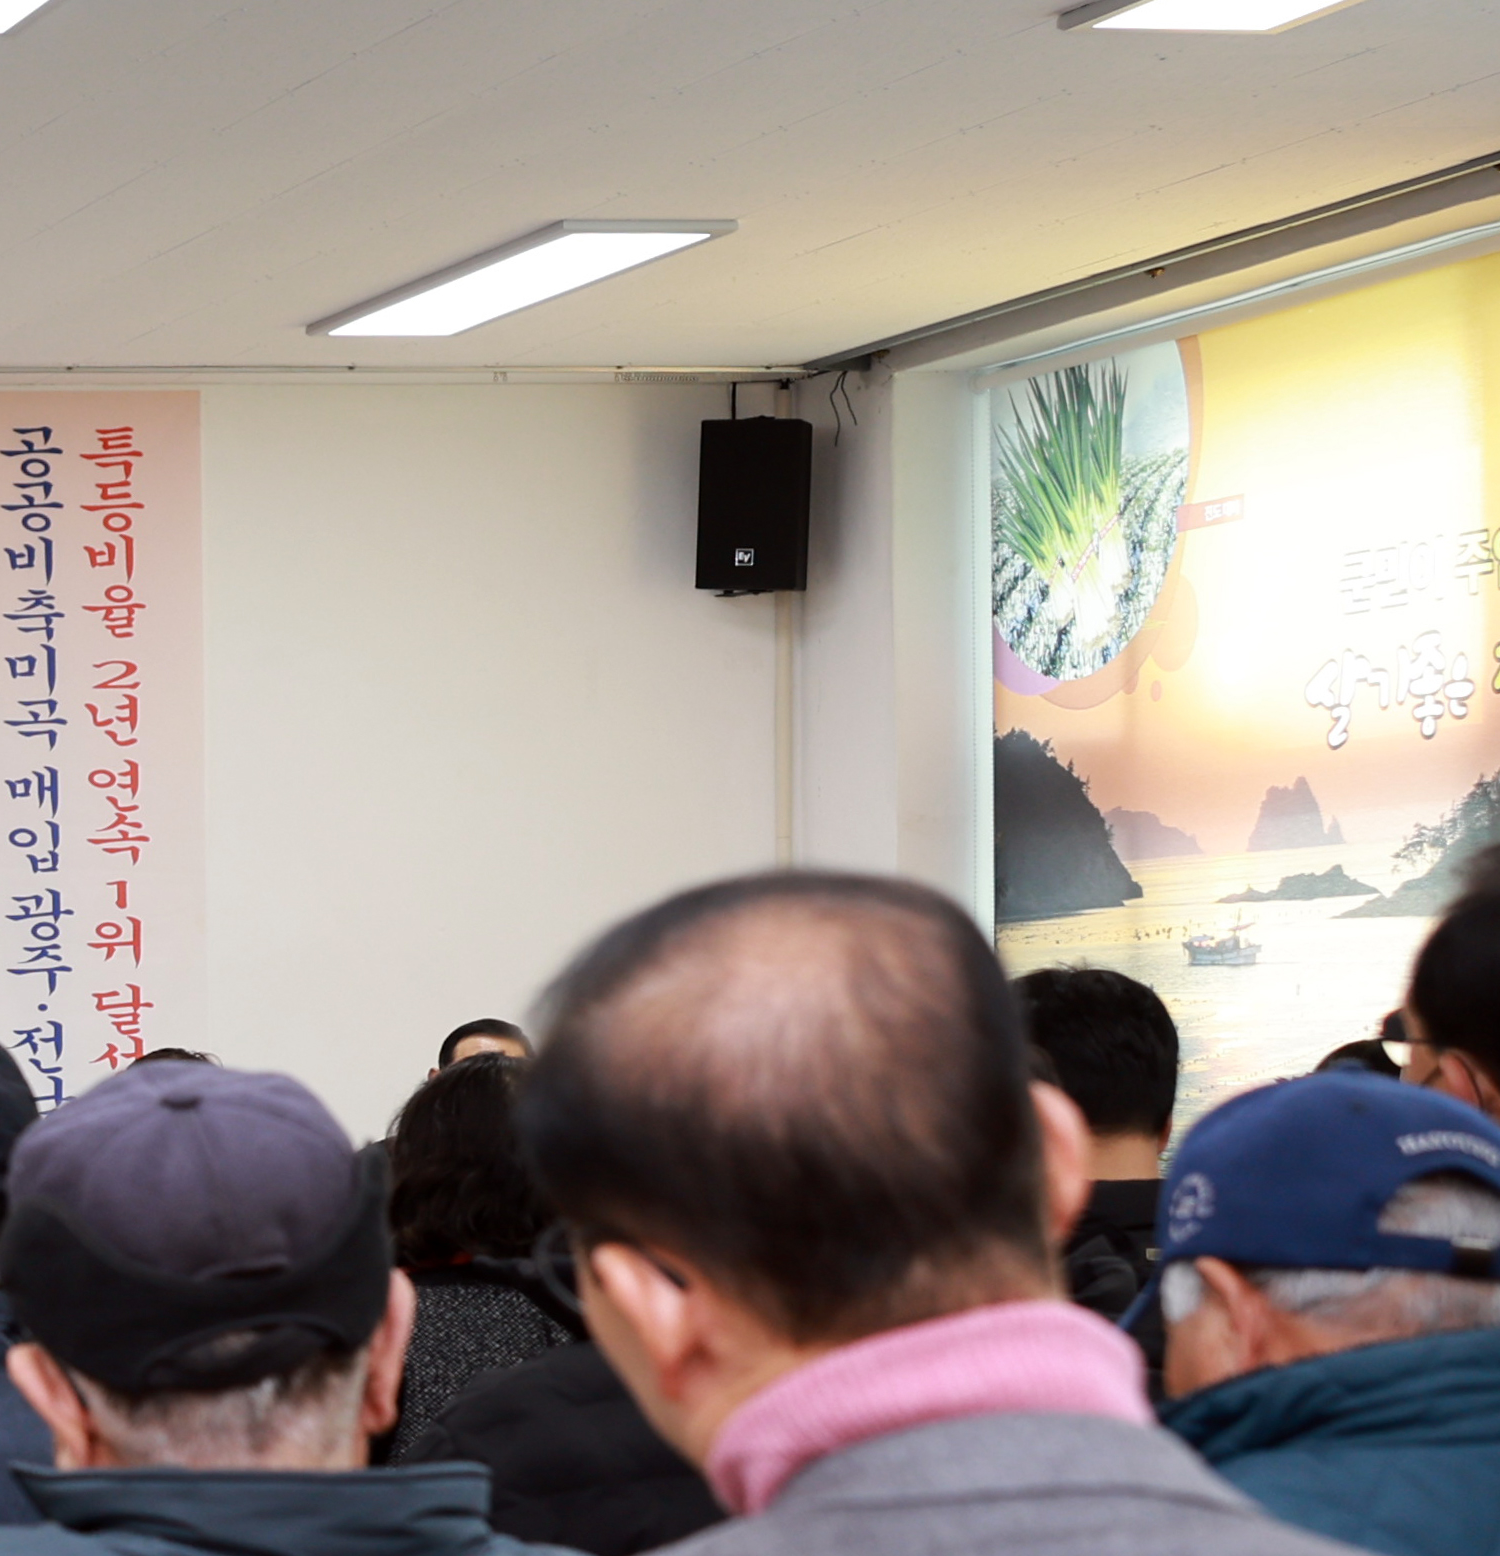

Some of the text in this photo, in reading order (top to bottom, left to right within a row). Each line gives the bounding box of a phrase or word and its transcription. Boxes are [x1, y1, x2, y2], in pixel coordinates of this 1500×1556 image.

[80, 426, 148, 639] 특등비율
[1455, 528, 1500, 597] 주
[0, 426, 67, 752] 공공비축미곡
[84, 660, 141, 747] 2년
[4, 765, 61, 874] 매입
[87, 758, 151, 867] 연속
[87, 879, 142, 970] 1위
